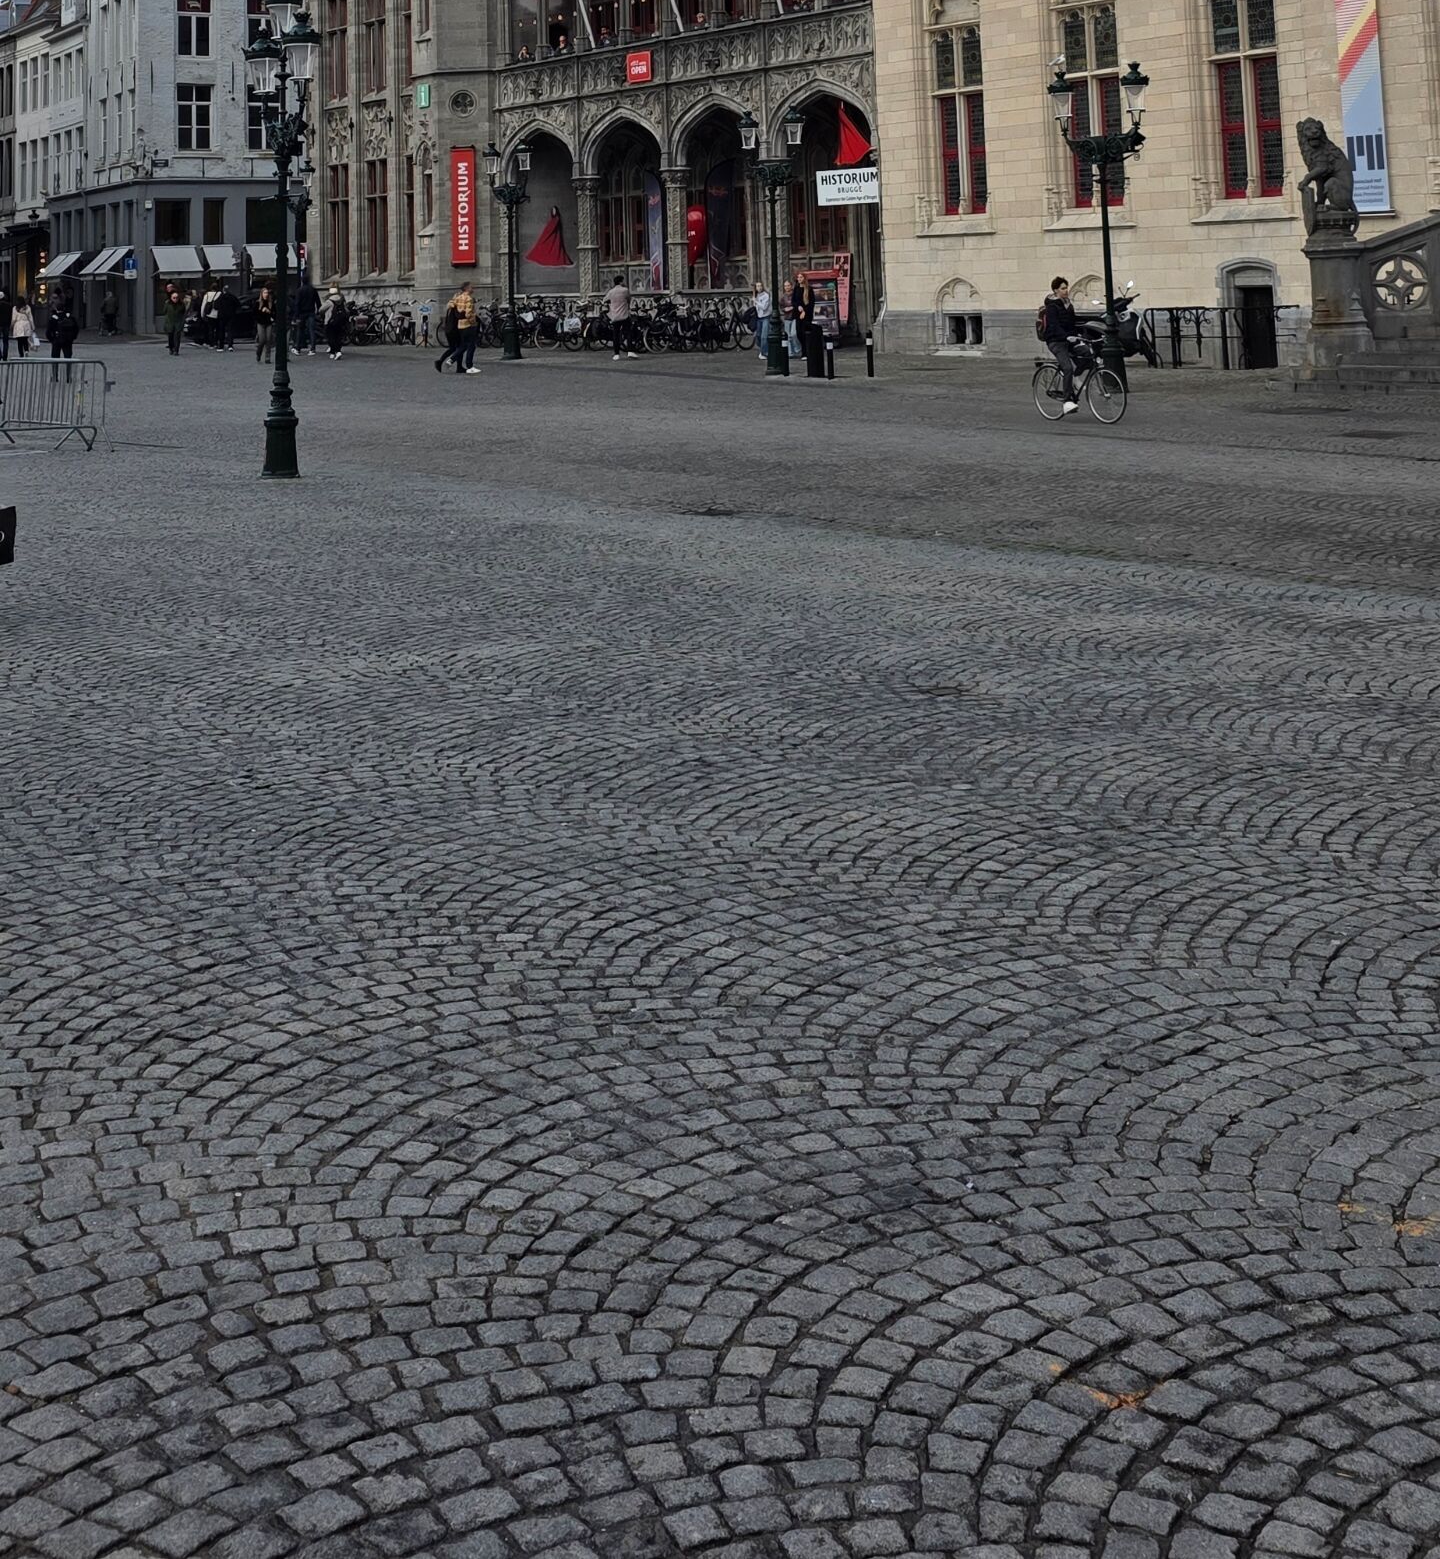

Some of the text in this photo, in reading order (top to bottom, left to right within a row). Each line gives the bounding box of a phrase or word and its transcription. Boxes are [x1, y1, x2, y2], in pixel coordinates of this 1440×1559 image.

[630, 65, 647, 74] OPEN
[821, 172, 879, 186] HISTORIUM
[458, 162, 470, 251] HISTORIUM
